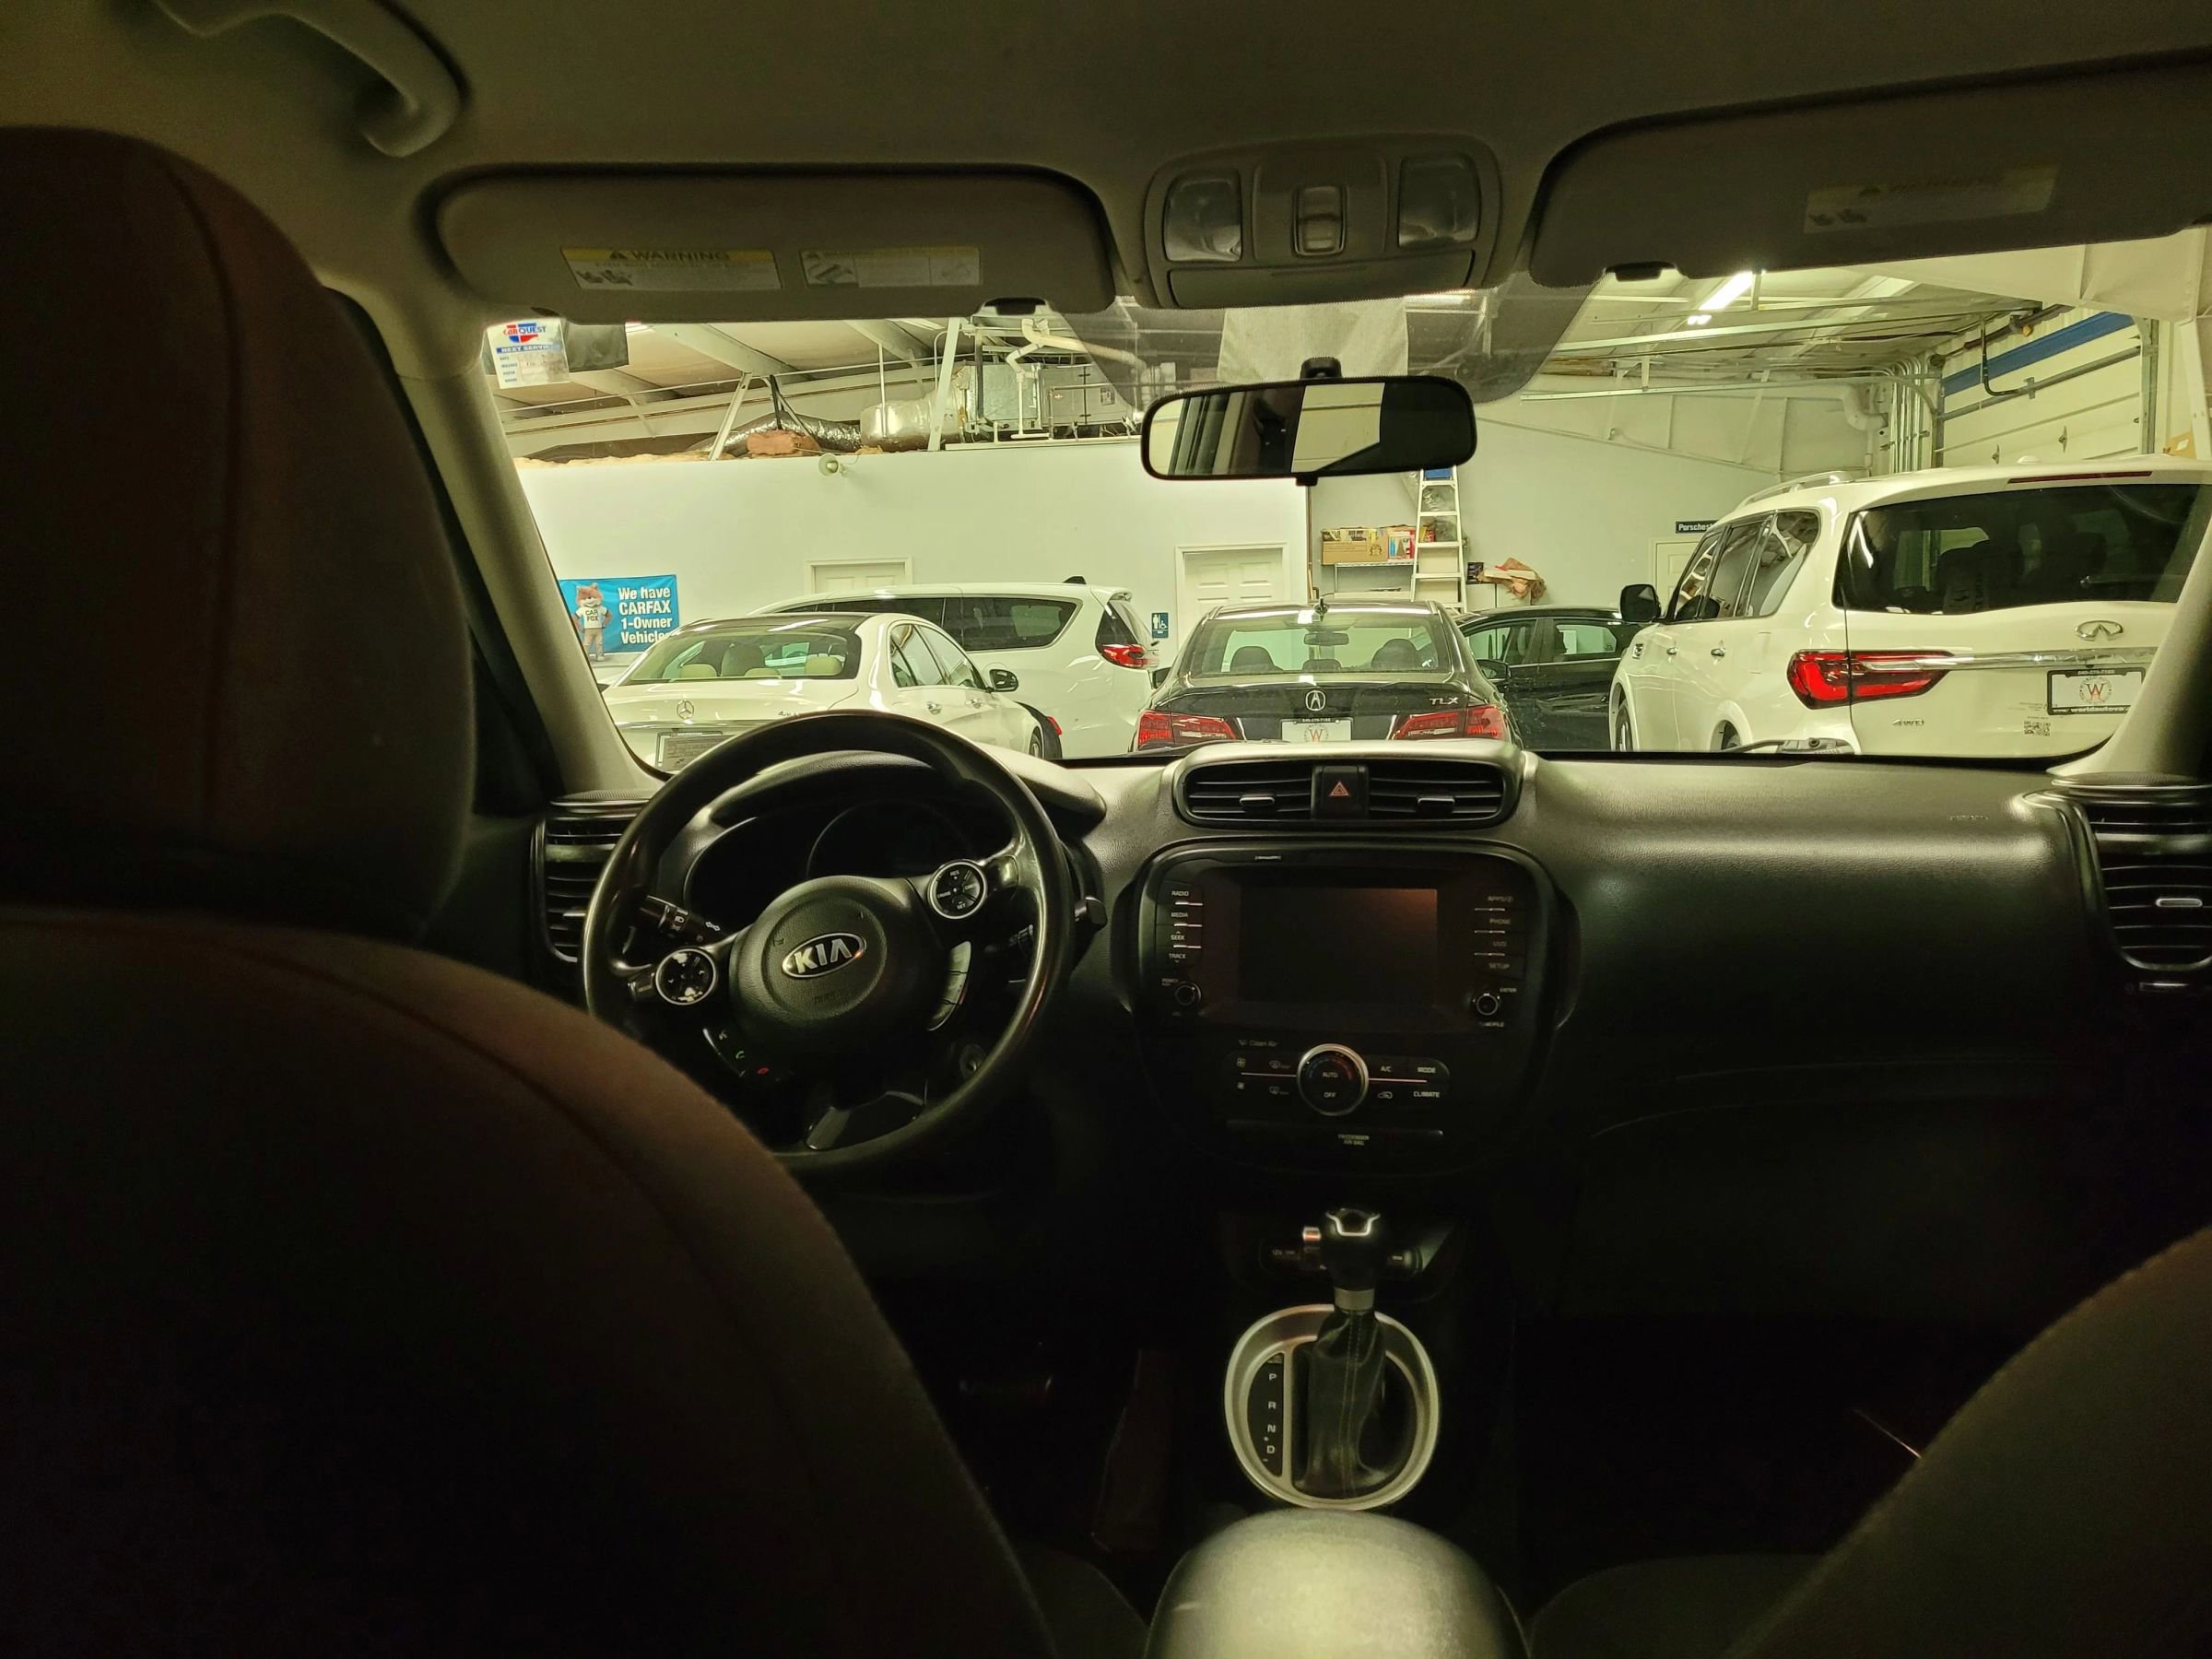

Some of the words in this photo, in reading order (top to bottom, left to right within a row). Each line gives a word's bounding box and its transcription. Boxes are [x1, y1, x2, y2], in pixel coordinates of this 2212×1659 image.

[632, 250, 730, 261] WARNING
[618, 587, 638, 600] We
[640, 586, 671, 599] have
[618, 599, 672, 616] CARFAX
[620, 617, 673, 629] 1-Owner
[620, 630, 670, 644] Vehicle
[1429, 697, 1459, 705] TLX
[794, 938, 853, 974] KIA
[1268, 1373, 1277, 1382] P
[1267, 1401, 1277, 1410] R
[1266, 1424, 1277, 1433] N
[1266, 1445, 1276, 1454] D
